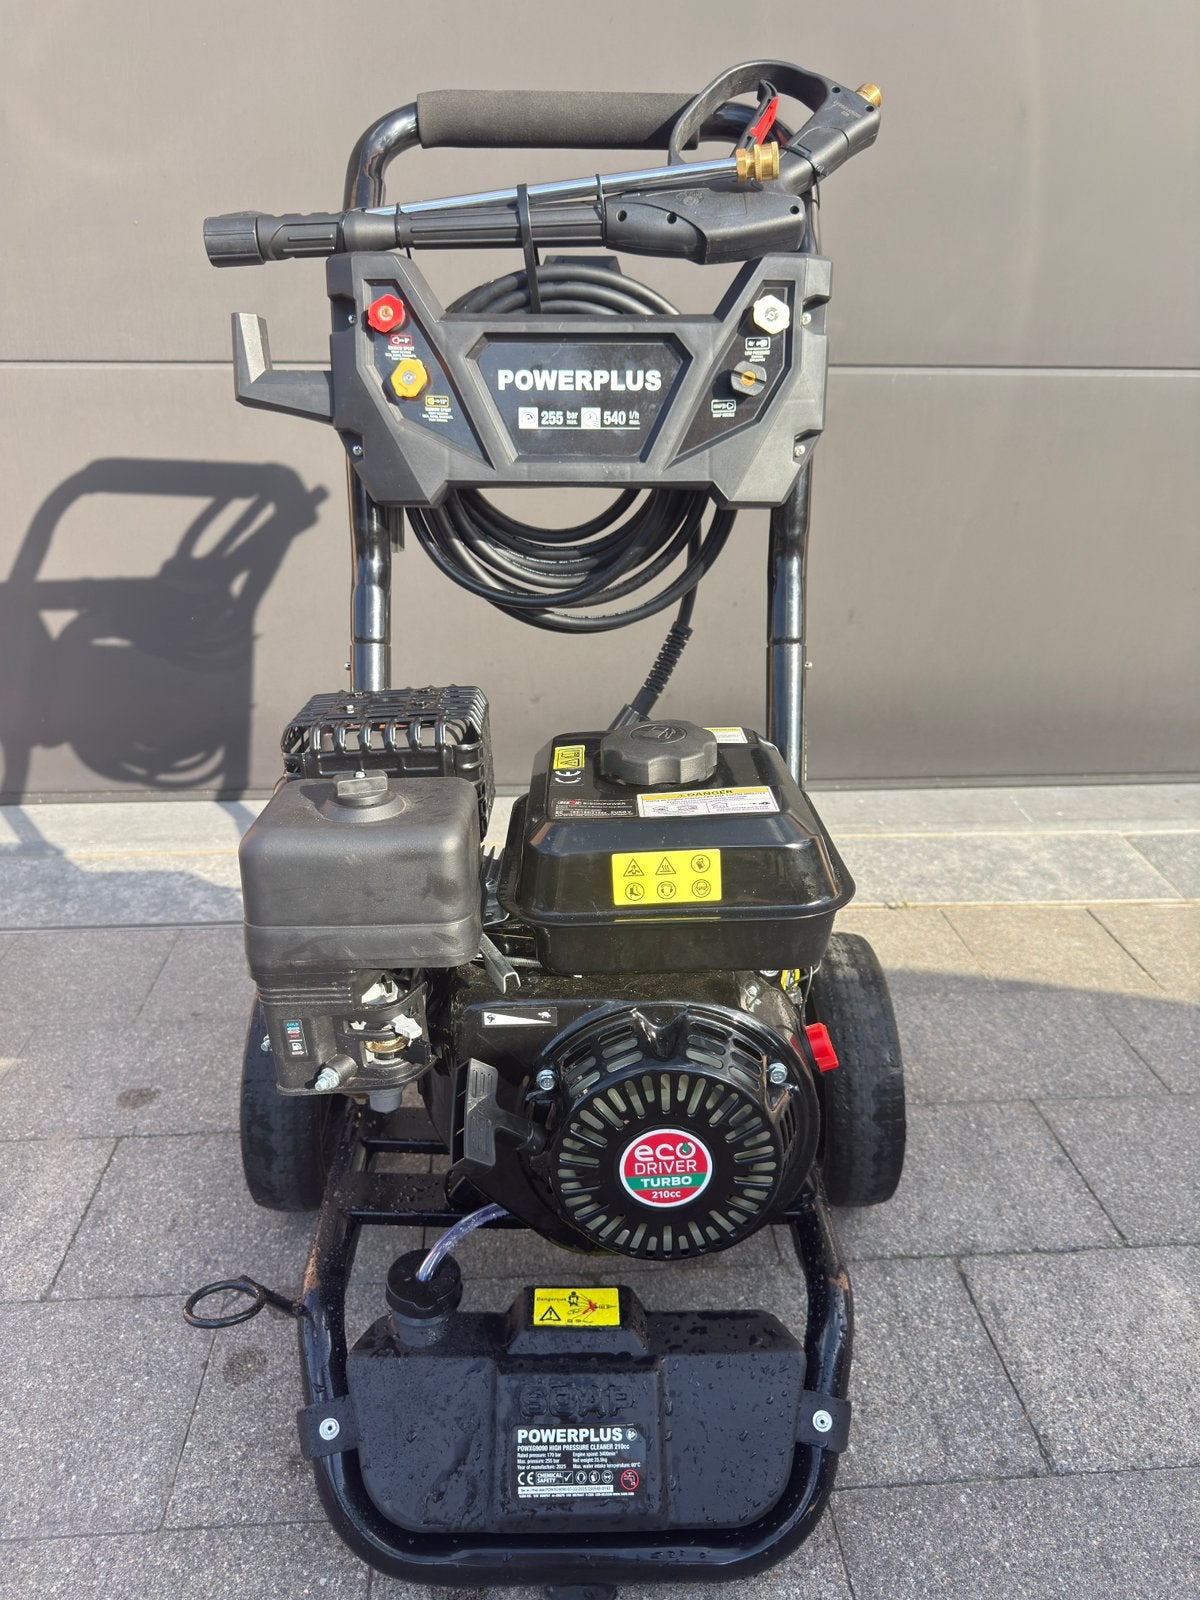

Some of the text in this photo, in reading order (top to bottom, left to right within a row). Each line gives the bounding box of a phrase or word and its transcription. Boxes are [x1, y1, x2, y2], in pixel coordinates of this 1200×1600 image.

[497, 369, 662, 391] POWERPLUS
[540, 410, 578, 425] 255 bar
[603, 410, 640, 425] 540 l/h
[687, 789, 733, 798] DANGER
[634, 1141, 696, 1162] eco
[634, 1159, 697, 1175] DRIVER
[640, 1176, 692, 1188] TURBO
[652, 1190, 681, 1199] 210cc
[517, 1427, 623, 1443] POWERPLUS
